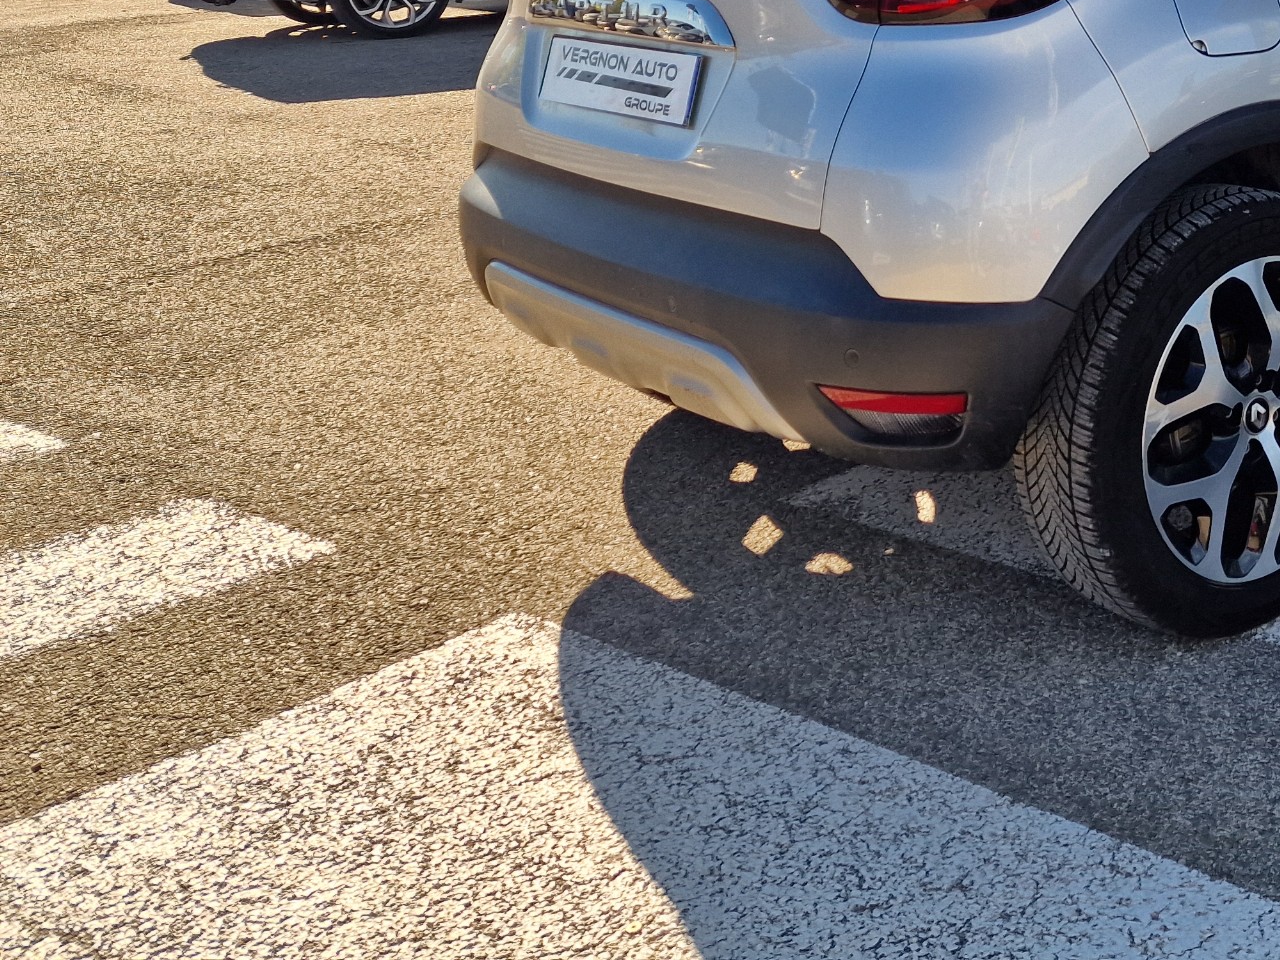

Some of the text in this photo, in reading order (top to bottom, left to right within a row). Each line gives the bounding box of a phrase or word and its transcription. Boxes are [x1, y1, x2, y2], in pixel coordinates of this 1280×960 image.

[562, 45, 679, 82] VERGNON AUTO
[624, 96, 671, 117] GROUPE
